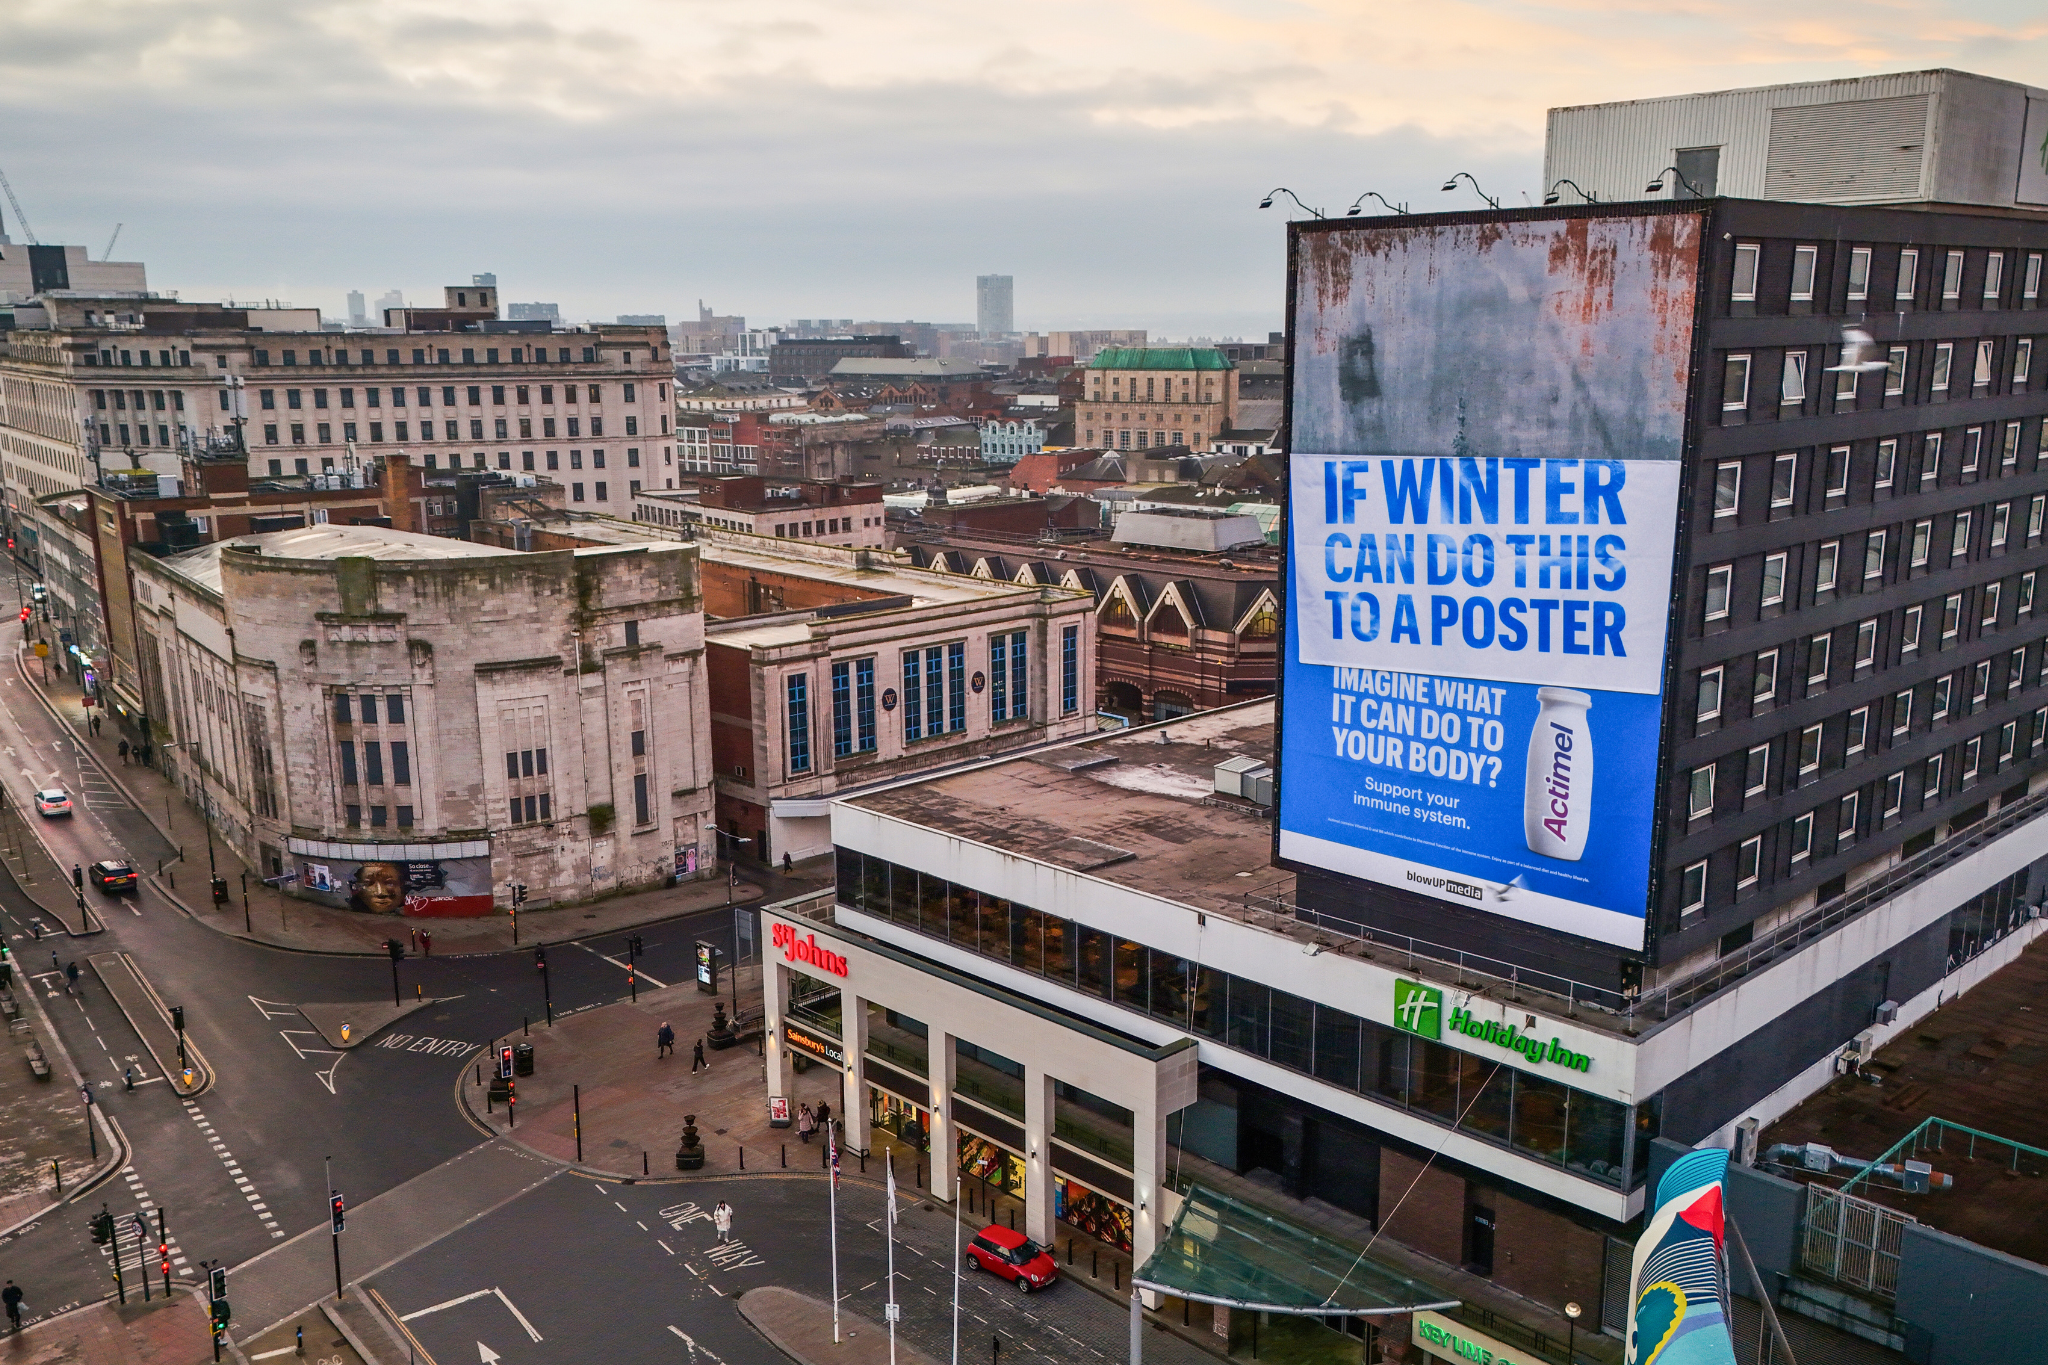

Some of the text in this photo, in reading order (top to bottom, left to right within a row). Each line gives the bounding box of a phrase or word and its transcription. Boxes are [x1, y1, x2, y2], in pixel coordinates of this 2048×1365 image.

[1324, 457, 1627, 526] IF WINTER
[1324, 532, 1627, 592] CAN DO THIS
[1324, 591, 1627, 658] TO A POSTER
[1333, 667, 1507, 717] IMAGINE WHAT
[1332, 693, 1505, 752] IT CAN DO TO
[1332, 726, 1503, 788] YOUR BODY?
[1542, 721, 1574, 842] Actimel
[1353, 790, 1471, 831] immune system.
[1364, 776, 1460, 811] Support your
[374, 1033, 481, 1058] NO ENTRY
[787, 1028, 825, 1054] Sainsbury's
[1448, 1006, 1591, 1074] Holiday Inn
[658, 1201, 766, 1272] ONE WAY
[50, 1300, 80, 1316] LEFT
[1419, 1319, 1494, 1365] KEY LIME
